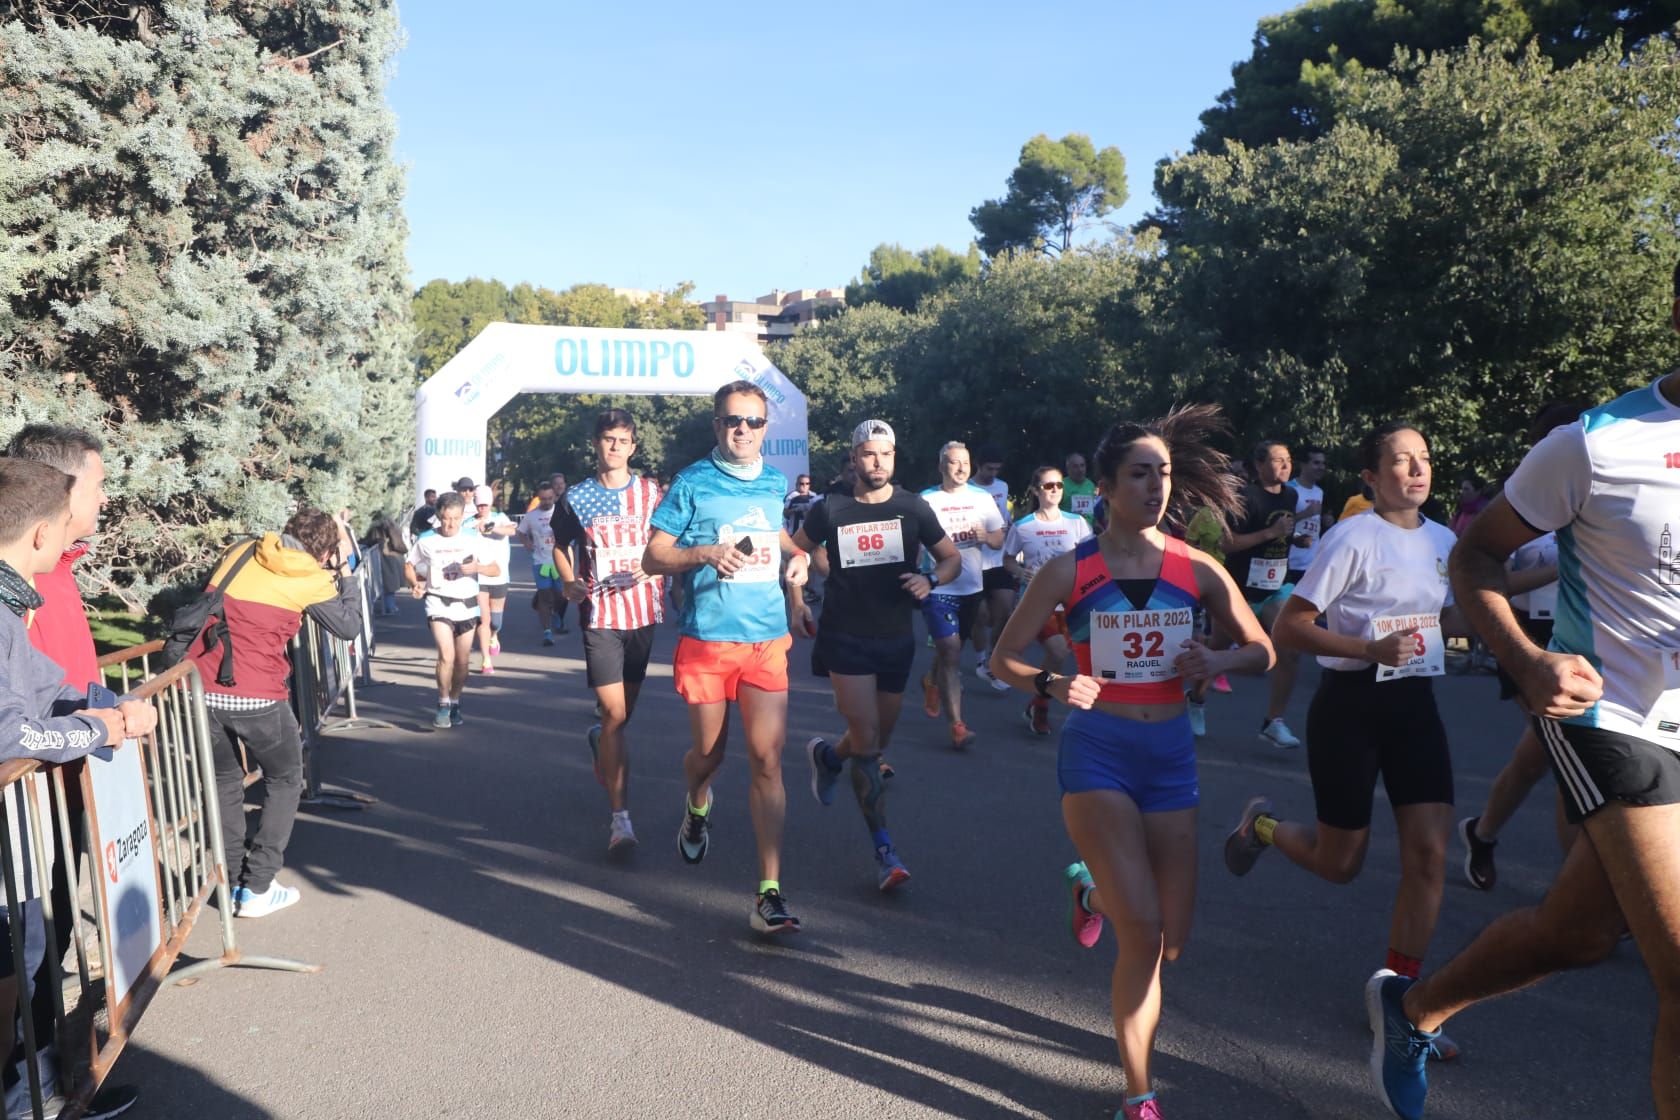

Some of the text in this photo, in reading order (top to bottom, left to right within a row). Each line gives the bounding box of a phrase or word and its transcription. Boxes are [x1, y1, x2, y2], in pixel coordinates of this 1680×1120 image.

[555, 338, 695, 377] OLIMPO
[754, 372, 785, 404] OLIMPO
[425, 438, 481, 457] OLIMPO
[760, 438, 808, 457] OLIMPO
[856, 524, 878, 533] PILAR
[881, 522, 898, 531] 2022
[857, 534, 884, 551] 86
[1267, 568, 1276, 580] 6
[1097, 610, 1191, 629] 10K PILAR 2022
[1377, 620, 1393, 632] 10K
[1123, 631, 1165, 659] 32
[1126, 660, 1161, 668] RAQUEL
[117, 819, 148, 863] Zaragoza
